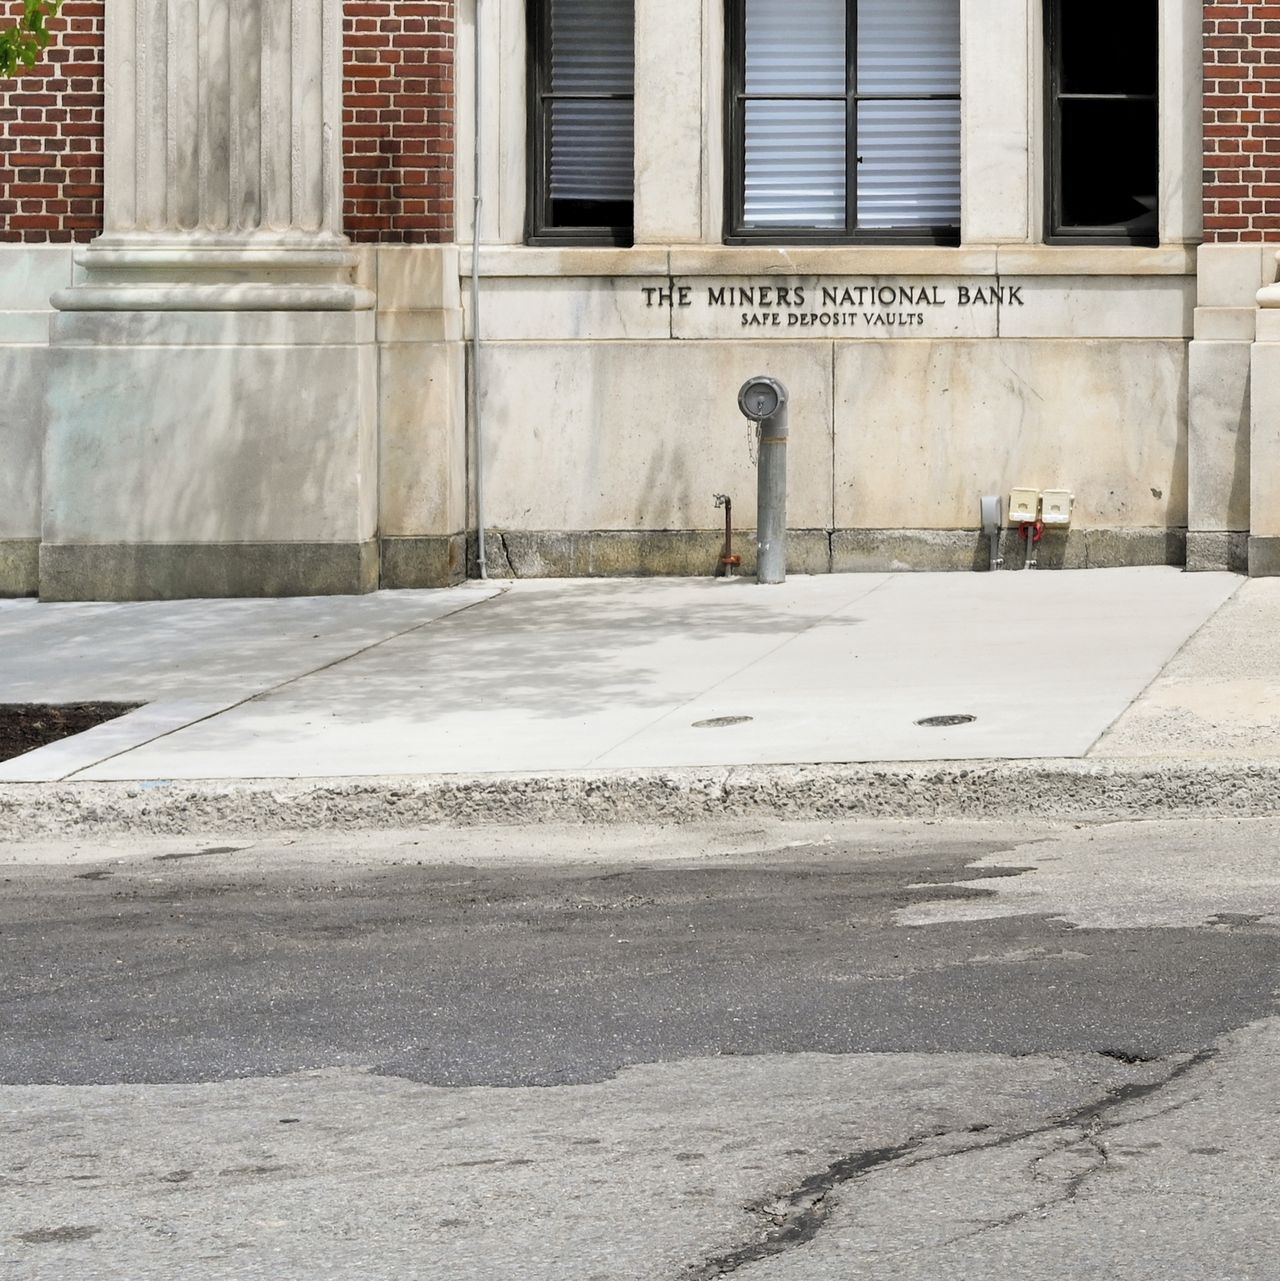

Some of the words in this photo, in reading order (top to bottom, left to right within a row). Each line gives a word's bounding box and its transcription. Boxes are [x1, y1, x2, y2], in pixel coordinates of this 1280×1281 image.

[641, 287, 692, 307] THE
[821, 286, 946, 306] NATIONAL
[957, 286, 1024, 306] BANK
[741, 312, 781, 326] SAFE
[787, 312, 858, 326] DEPOSIT
[863, 312, 924, 326] VAULTS
